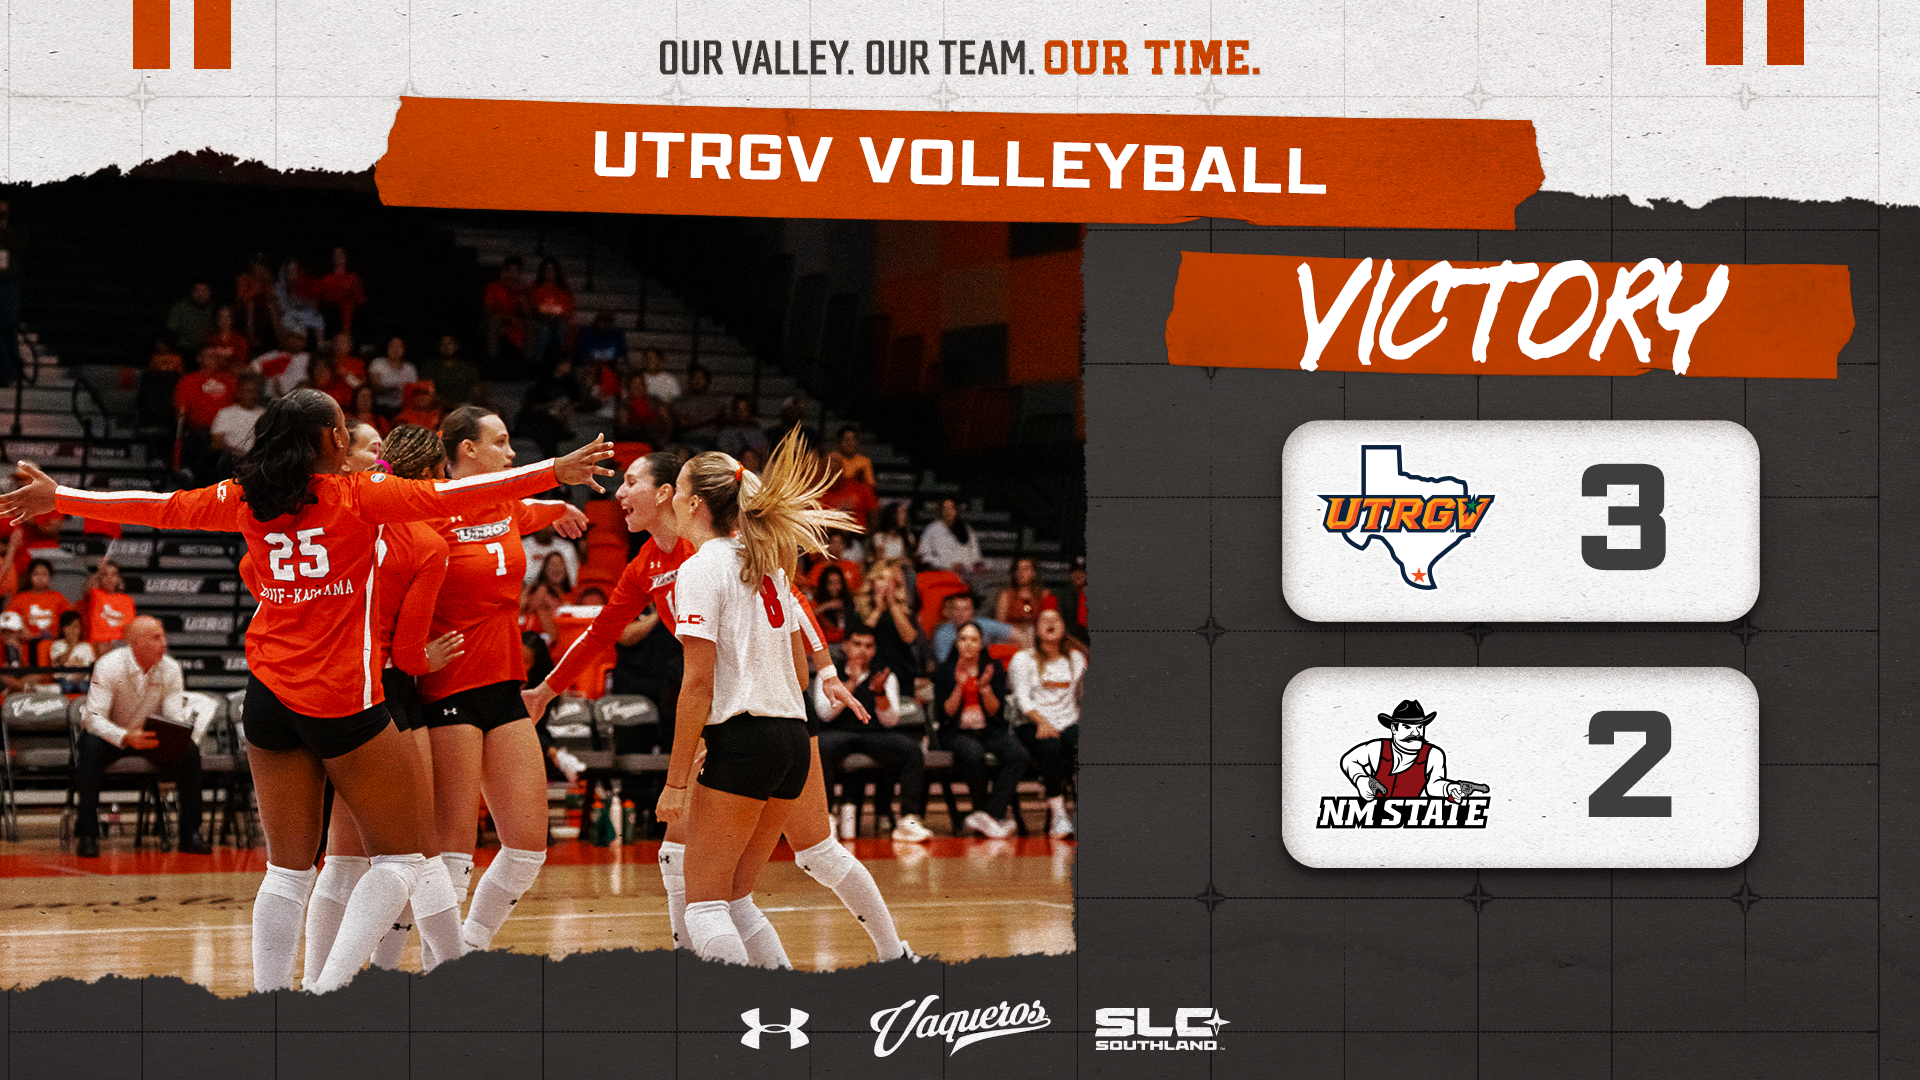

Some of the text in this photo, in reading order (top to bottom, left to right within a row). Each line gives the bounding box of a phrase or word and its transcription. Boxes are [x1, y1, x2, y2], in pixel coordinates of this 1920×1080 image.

[263, 526, 330, 581] 25
[485, 542, 507, 576] 7
[676, 614, 702, 625] LC
[760, 574, 785, 629] 8
